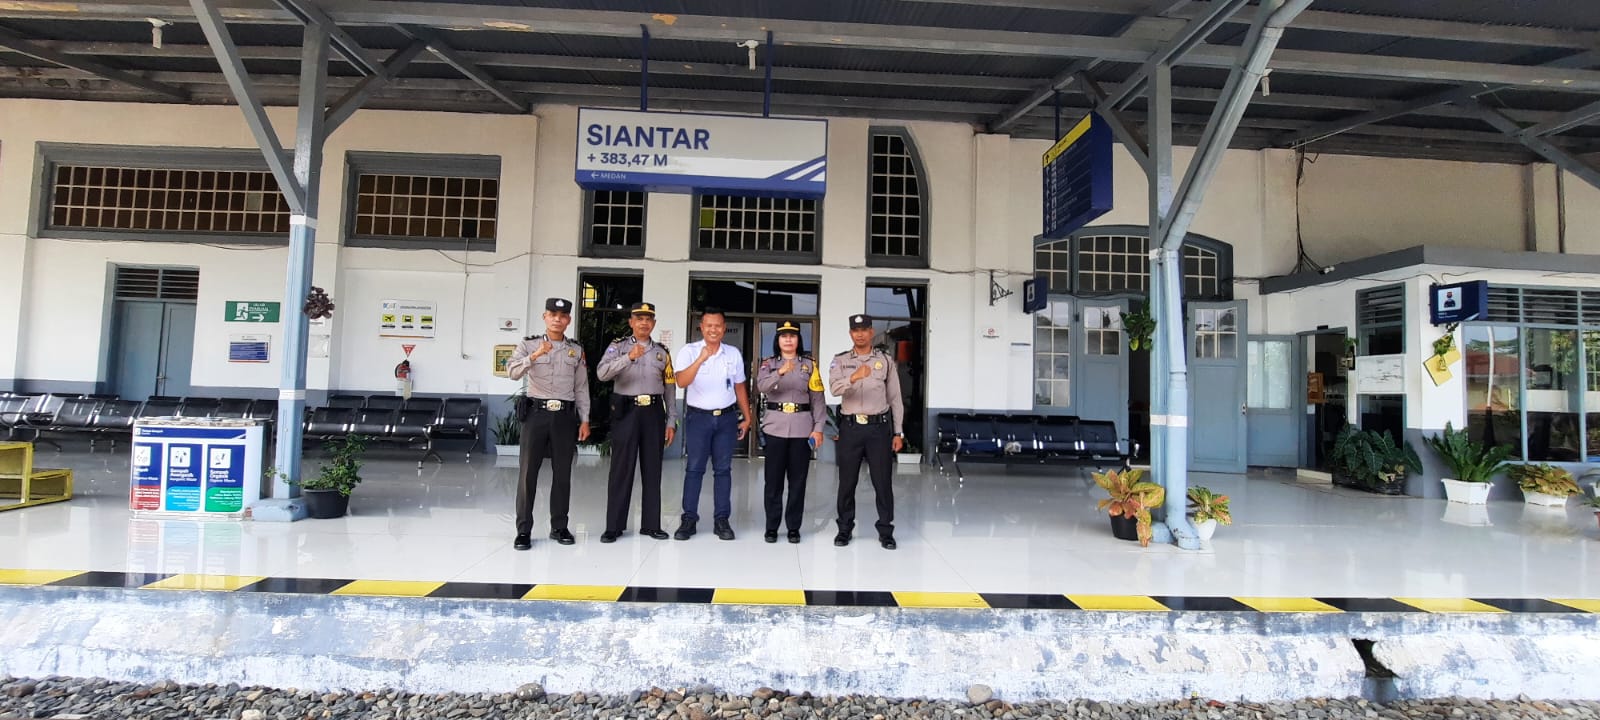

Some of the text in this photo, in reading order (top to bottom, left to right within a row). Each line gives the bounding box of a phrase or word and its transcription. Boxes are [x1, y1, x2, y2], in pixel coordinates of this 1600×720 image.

[586, 124, 710, 150] SIANTAR
[600, 152, 650, 167] 383,47
[653, 154, 668, 166] M
[600, 172, 627, 180] MEDAN
